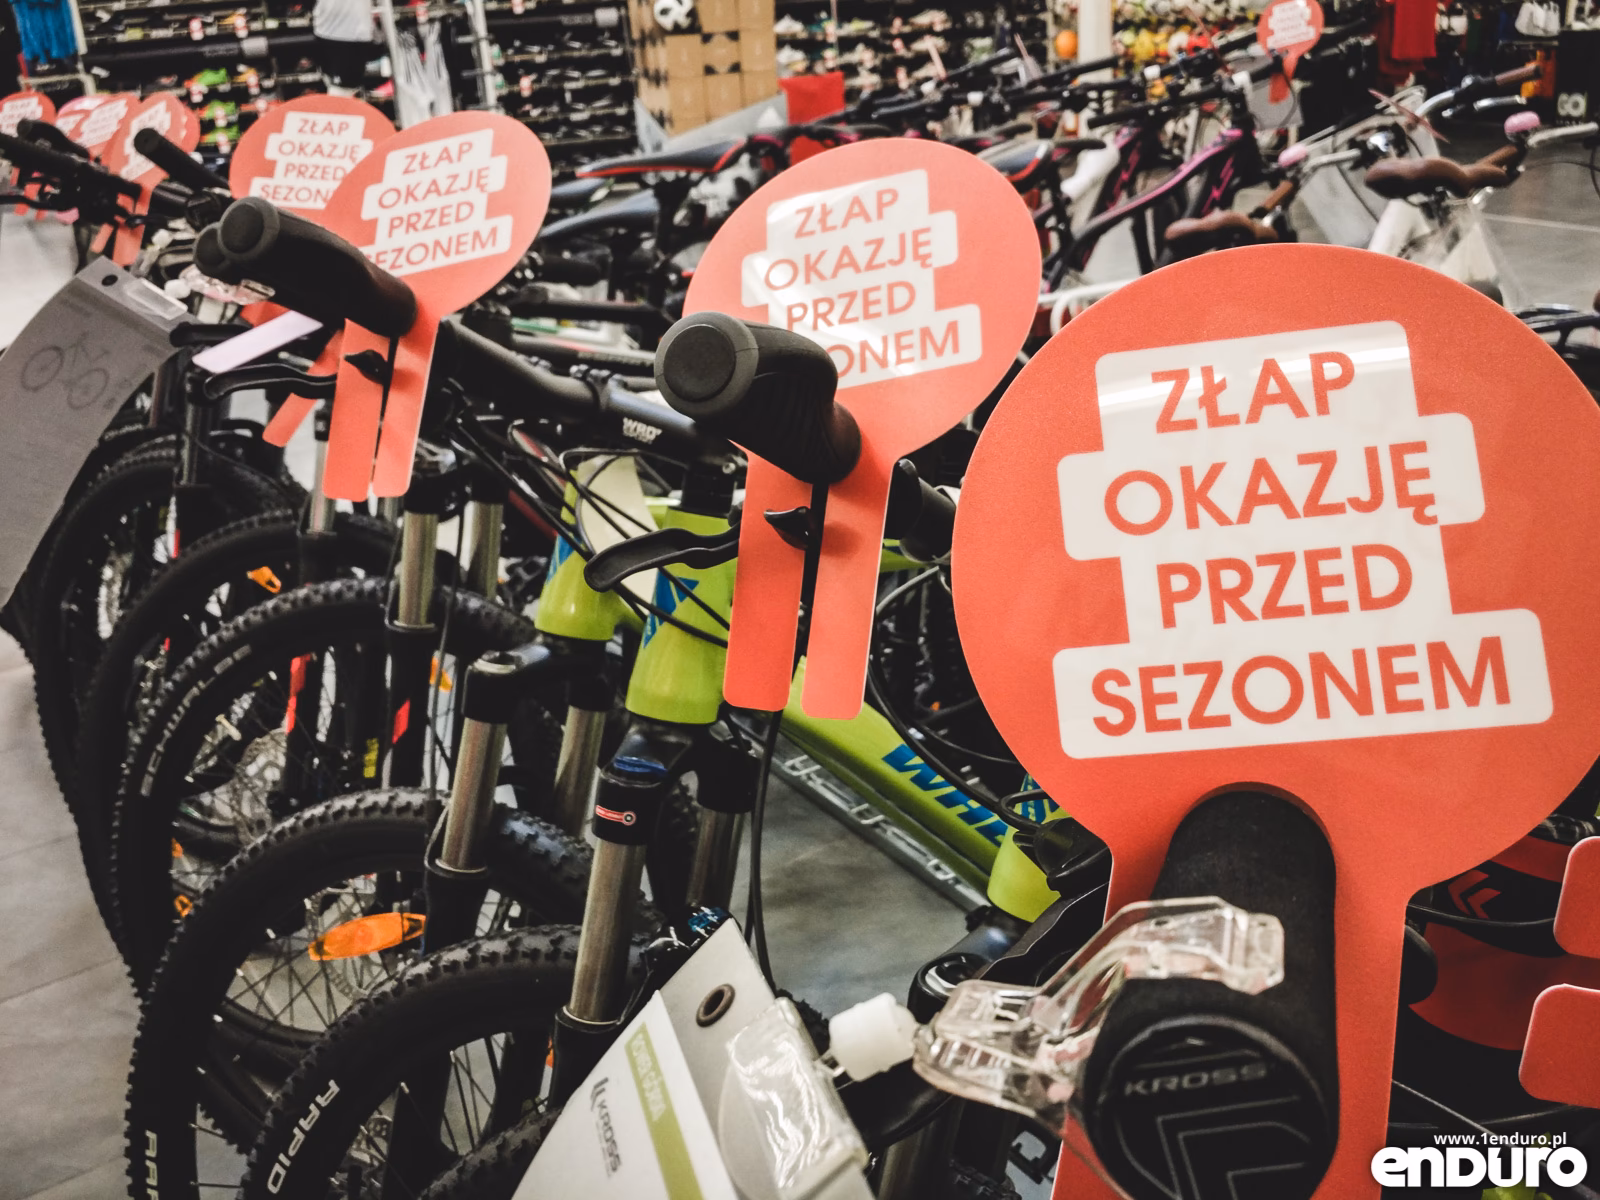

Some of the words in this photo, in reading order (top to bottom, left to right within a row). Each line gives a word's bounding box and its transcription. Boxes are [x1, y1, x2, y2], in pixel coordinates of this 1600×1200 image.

[278, 140, 360, 163] OKAZJĘ
[298, 118, 349, 136] ZŁAP
[284, 163, 347, 181] PRZED
[402, 141, 473, 175] ZŁAP
[260, 184, 334, 204] SEZON
[378, 166, 490, 209] OKAZJĘ
[387, 201, 475, 239] PRZED
[794, 188, 899, 239] ZŁAP
[366, 226, 498, 271] EZONEM
[764, 226, 933, 291] OKAZJĘ
[786, 280, 916, 331] PRZED
[826, 320, 960, 379] ONEM
[1151, 351, 1355, 434] ZŁAP
[1104, 440, 1439, 536] OKAZJĘ
[1156, 543, 1412, 630] PRZED
[1091, 636, 1511, 737] SEZONEM
[1124, 1062, 1267, 1096] KROSS
[267, 1079, 340, 1194] RAPID
[596, 1098, 622, 1174] KROSS
